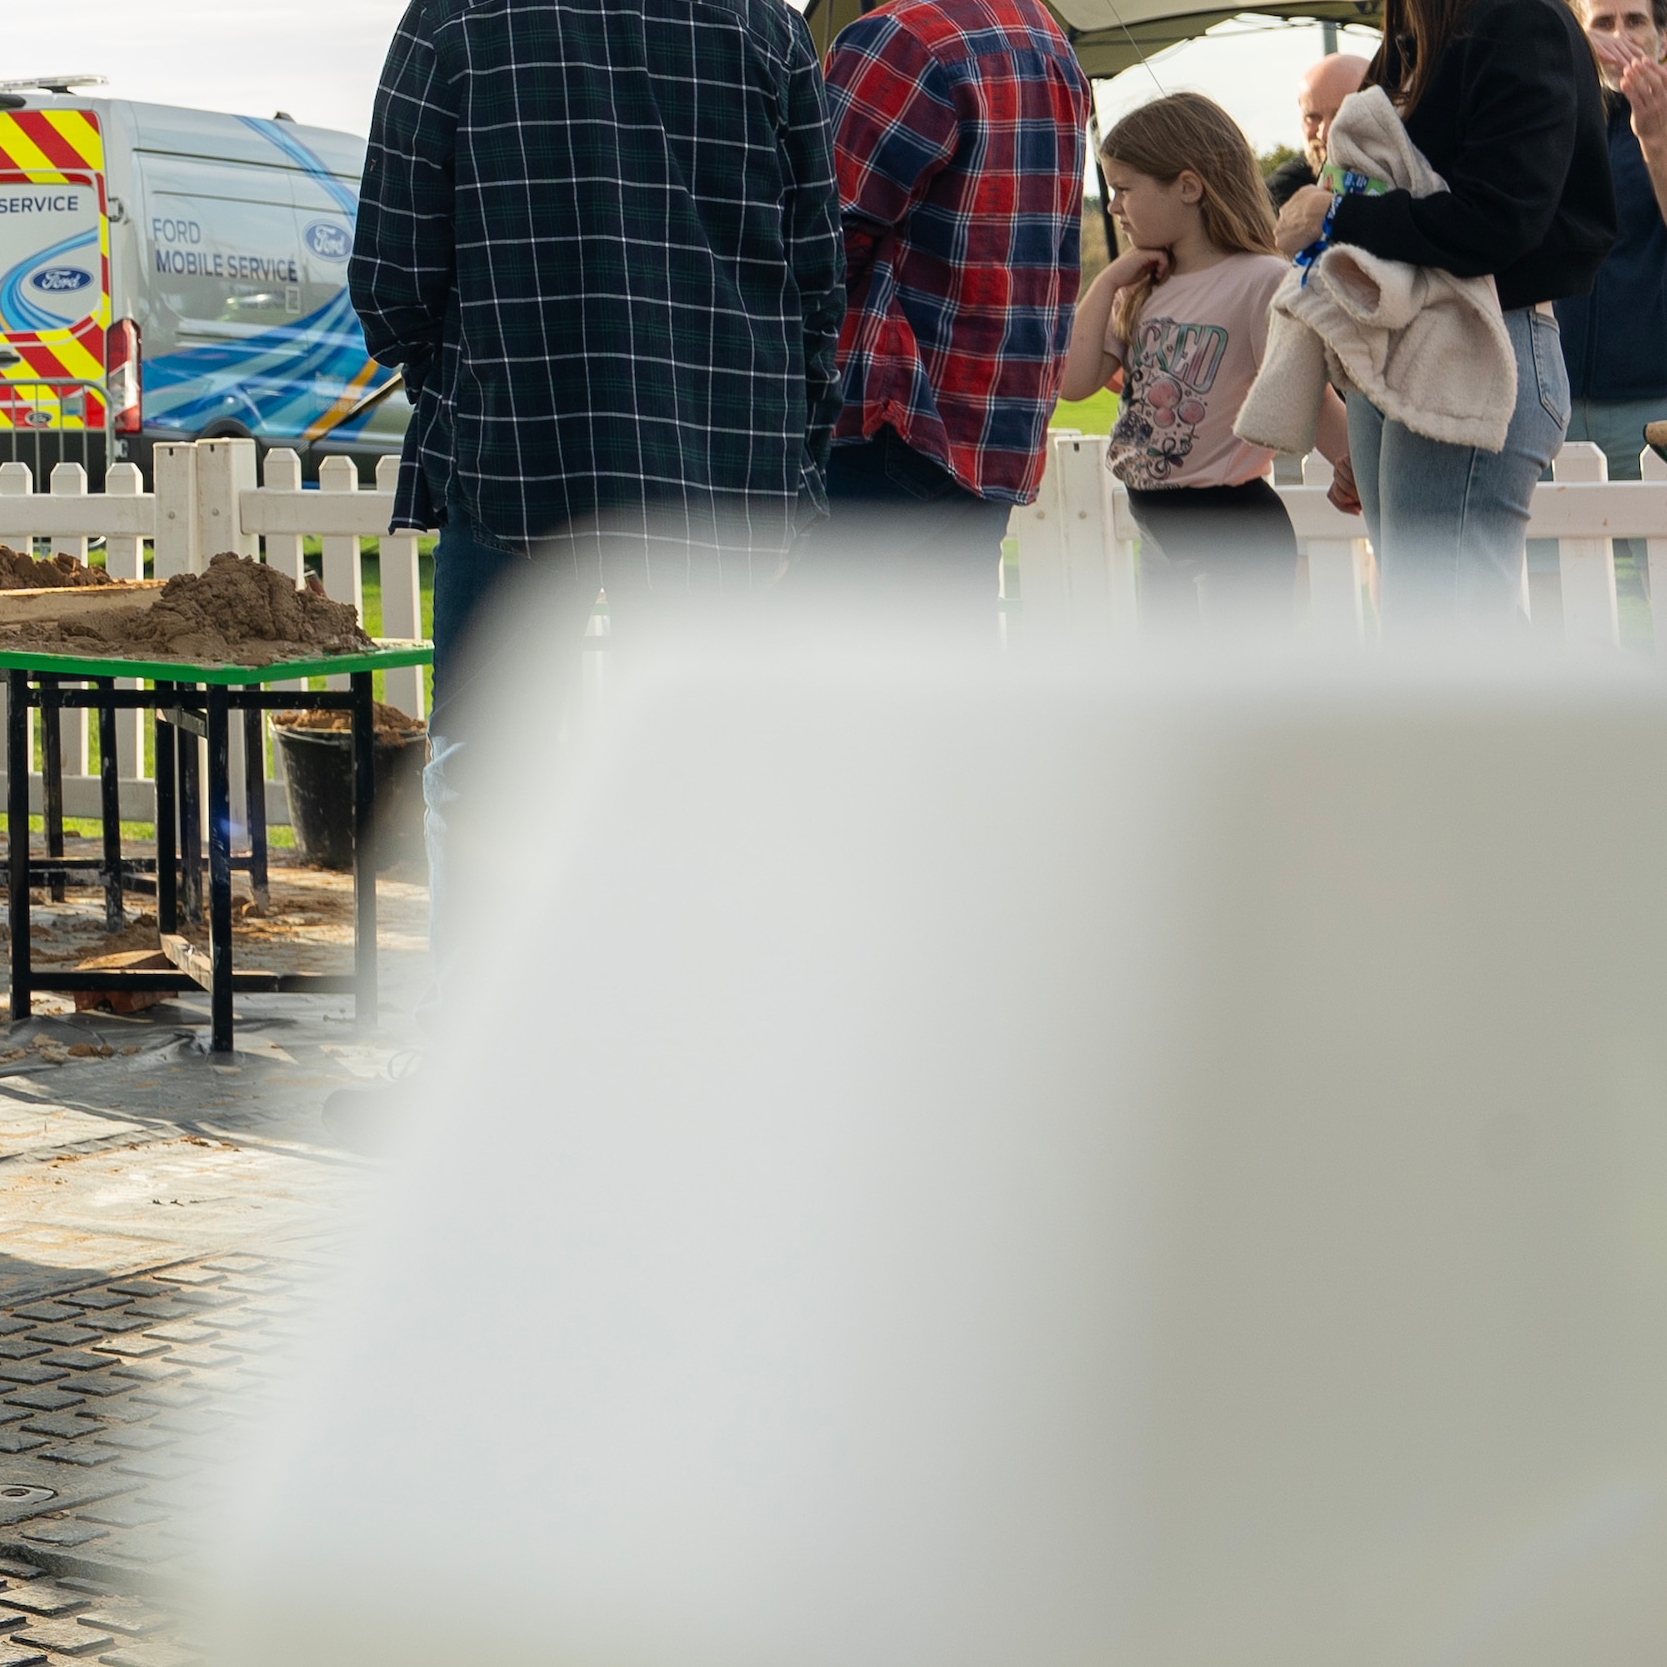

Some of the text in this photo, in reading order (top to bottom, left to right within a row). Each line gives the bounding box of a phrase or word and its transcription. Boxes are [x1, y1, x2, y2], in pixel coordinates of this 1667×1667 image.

[152, 218, 202, 245] FORD
[155, 248, 298, 283] MOBILE SERVICE
[40, 270, 82, 291] Ford
